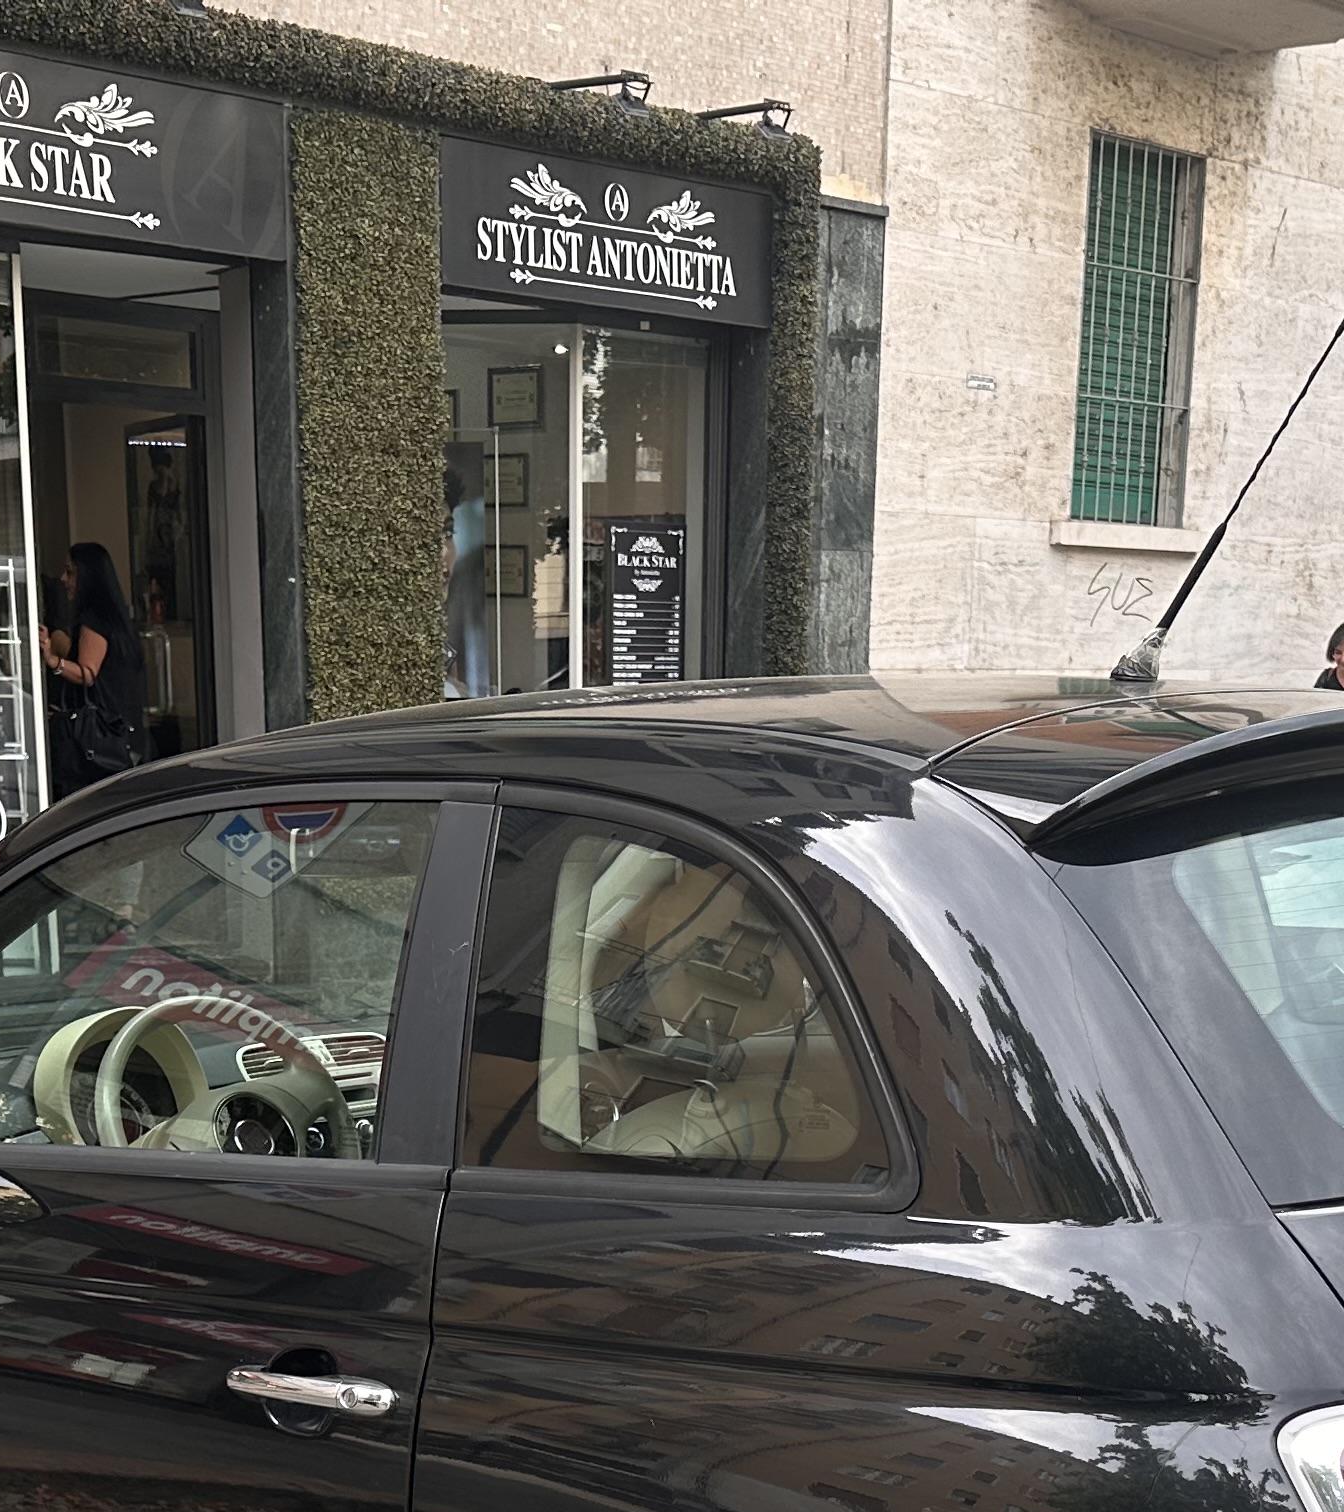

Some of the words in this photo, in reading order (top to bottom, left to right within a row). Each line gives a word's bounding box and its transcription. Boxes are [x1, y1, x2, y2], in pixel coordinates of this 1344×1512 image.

[30, 142, 116, 203] STAR
[476, 216, 584, 274] STYLIST
[586, 235, 738, 297] ANTONIETTA
[617, 553, 651, 568] BLACK
[651, 554, 677, 568] STAR
